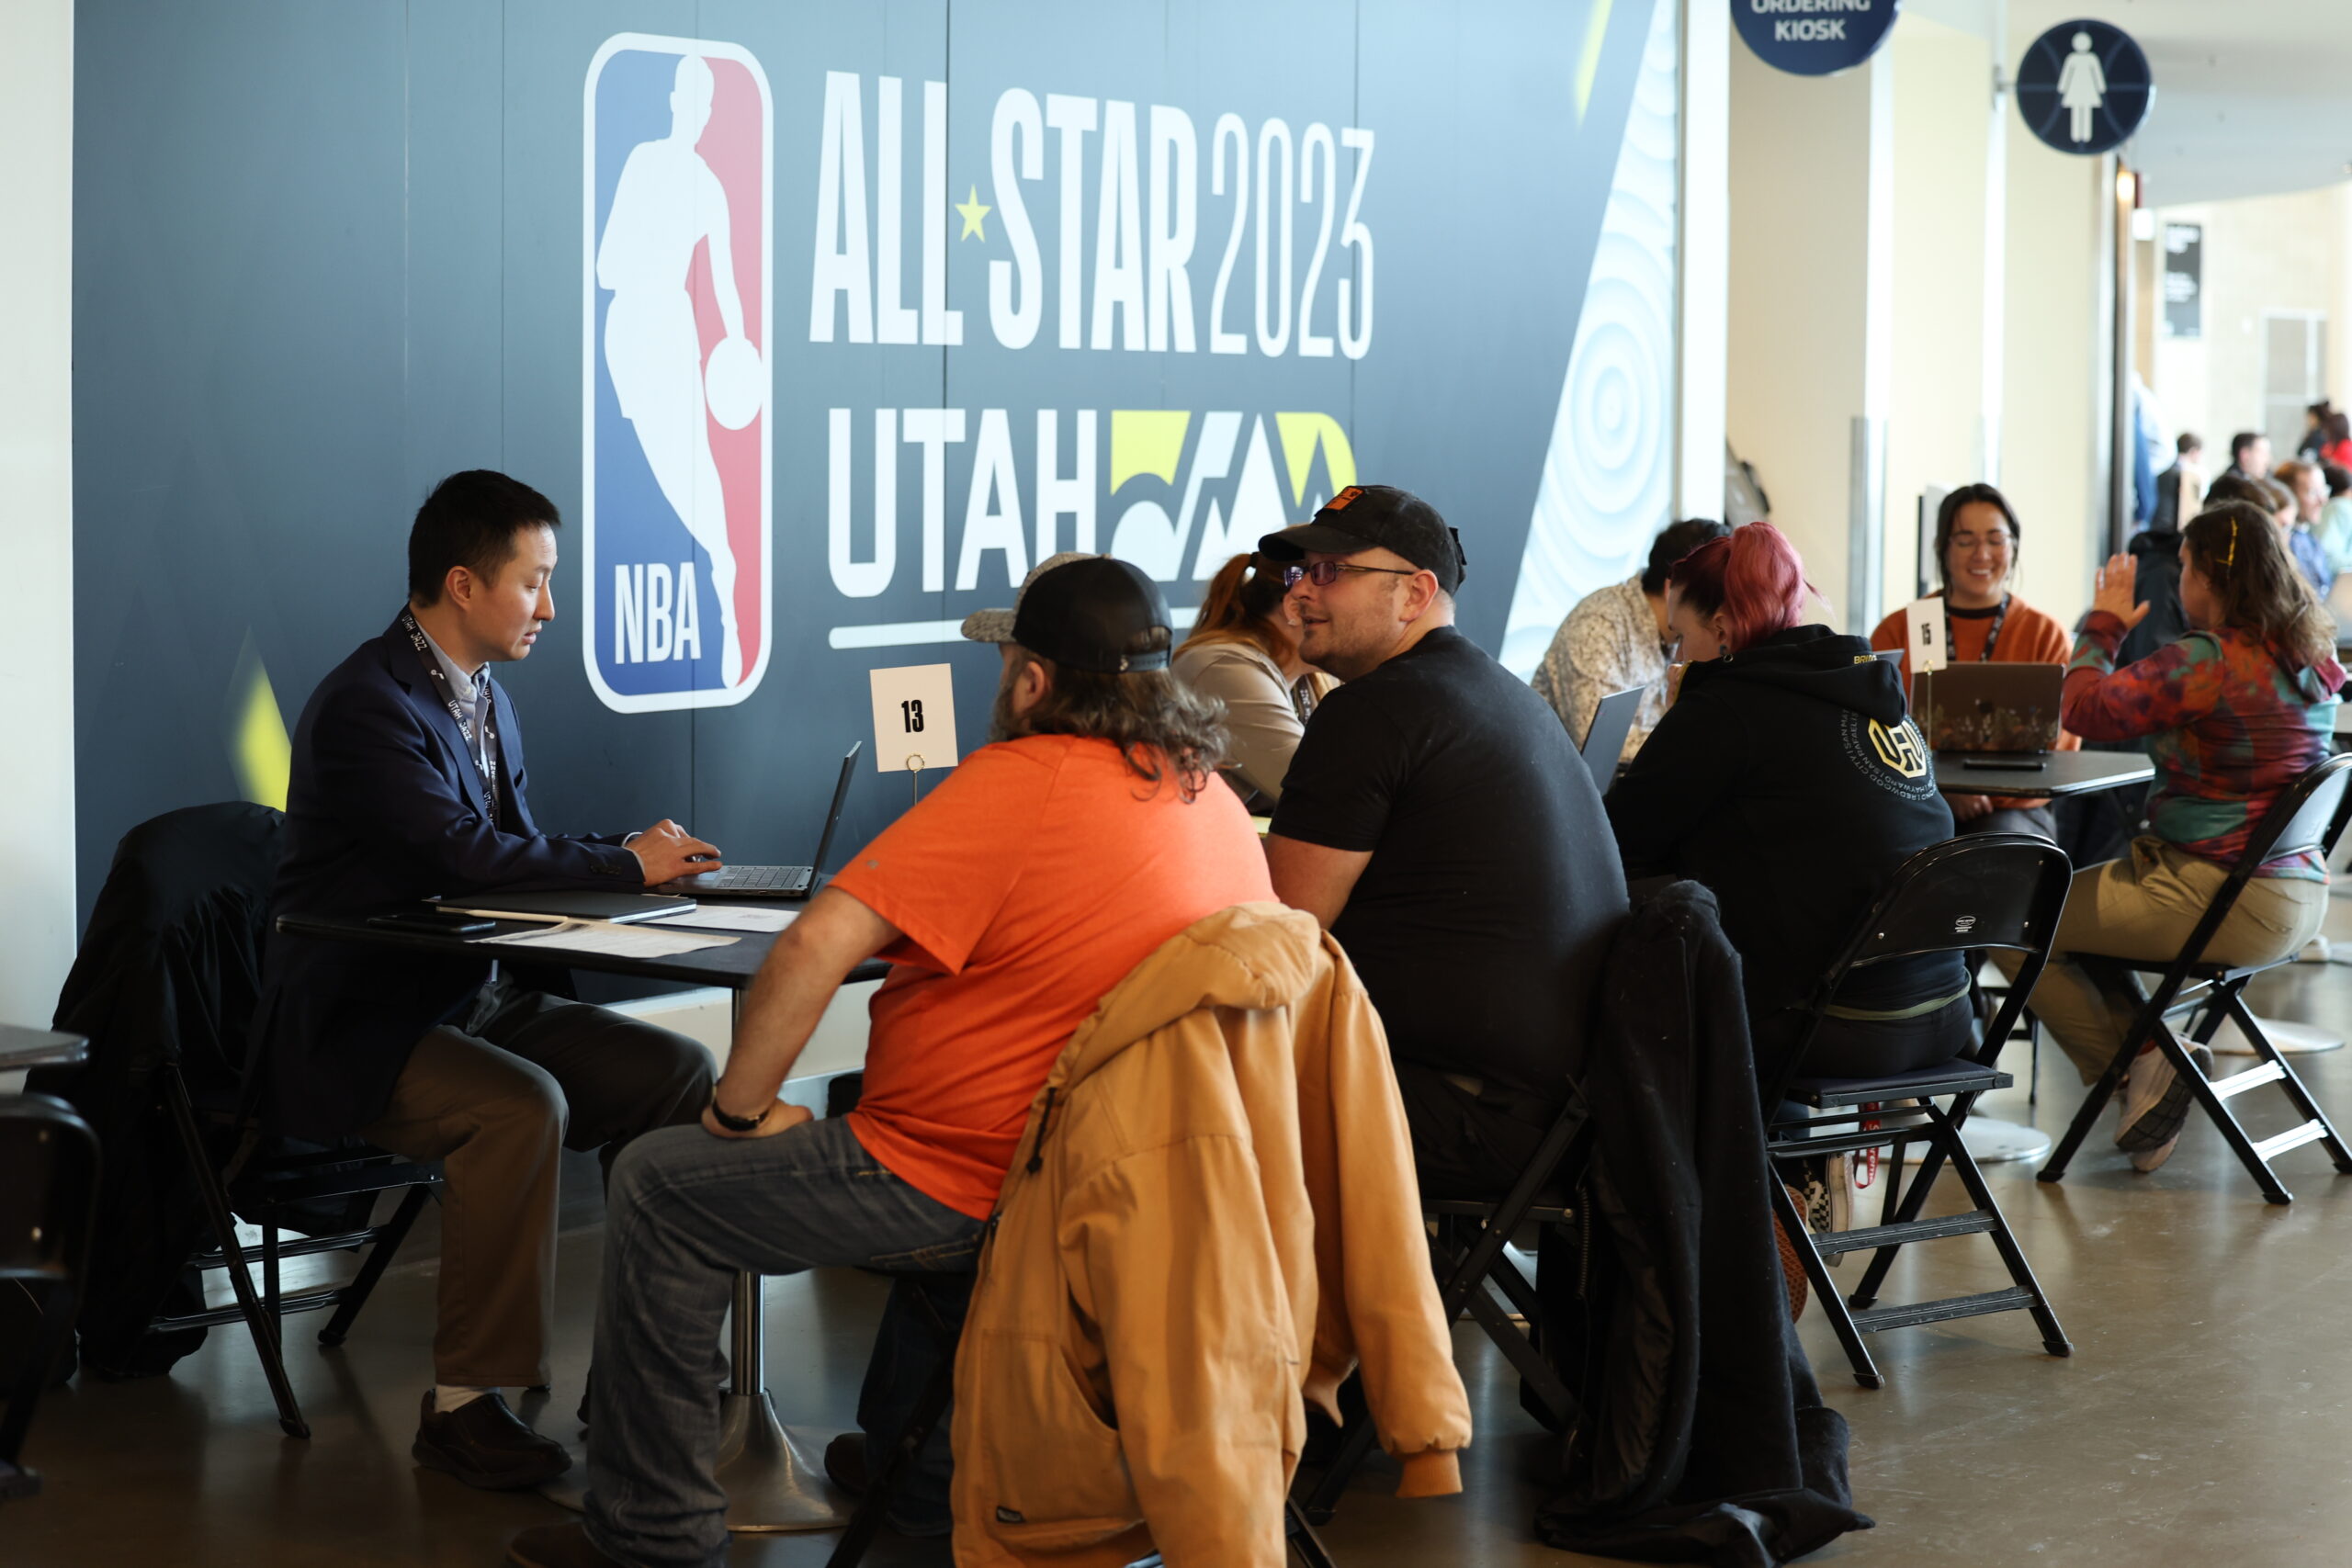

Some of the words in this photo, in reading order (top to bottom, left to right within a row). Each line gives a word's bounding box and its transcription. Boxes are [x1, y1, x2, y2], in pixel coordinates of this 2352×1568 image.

[1774, 19, 1846, 41] KIOSK
[809, 70, 963, 346] ALL
[989, 87, 1196, 354] STAR
[1210, 112, 1375, 360] 2023
[829, 408, 1097, 598] UTAH
[615, 562, 701, 664] NBA
[410, 632, 427, 651] JAZZ
[448, 700, 464, 719] UTAH
[458, 721, 472, 741] JAZZ
[900, 699, 924, 733] 13
[1870, 774, 1918, 801] REDWOOD
